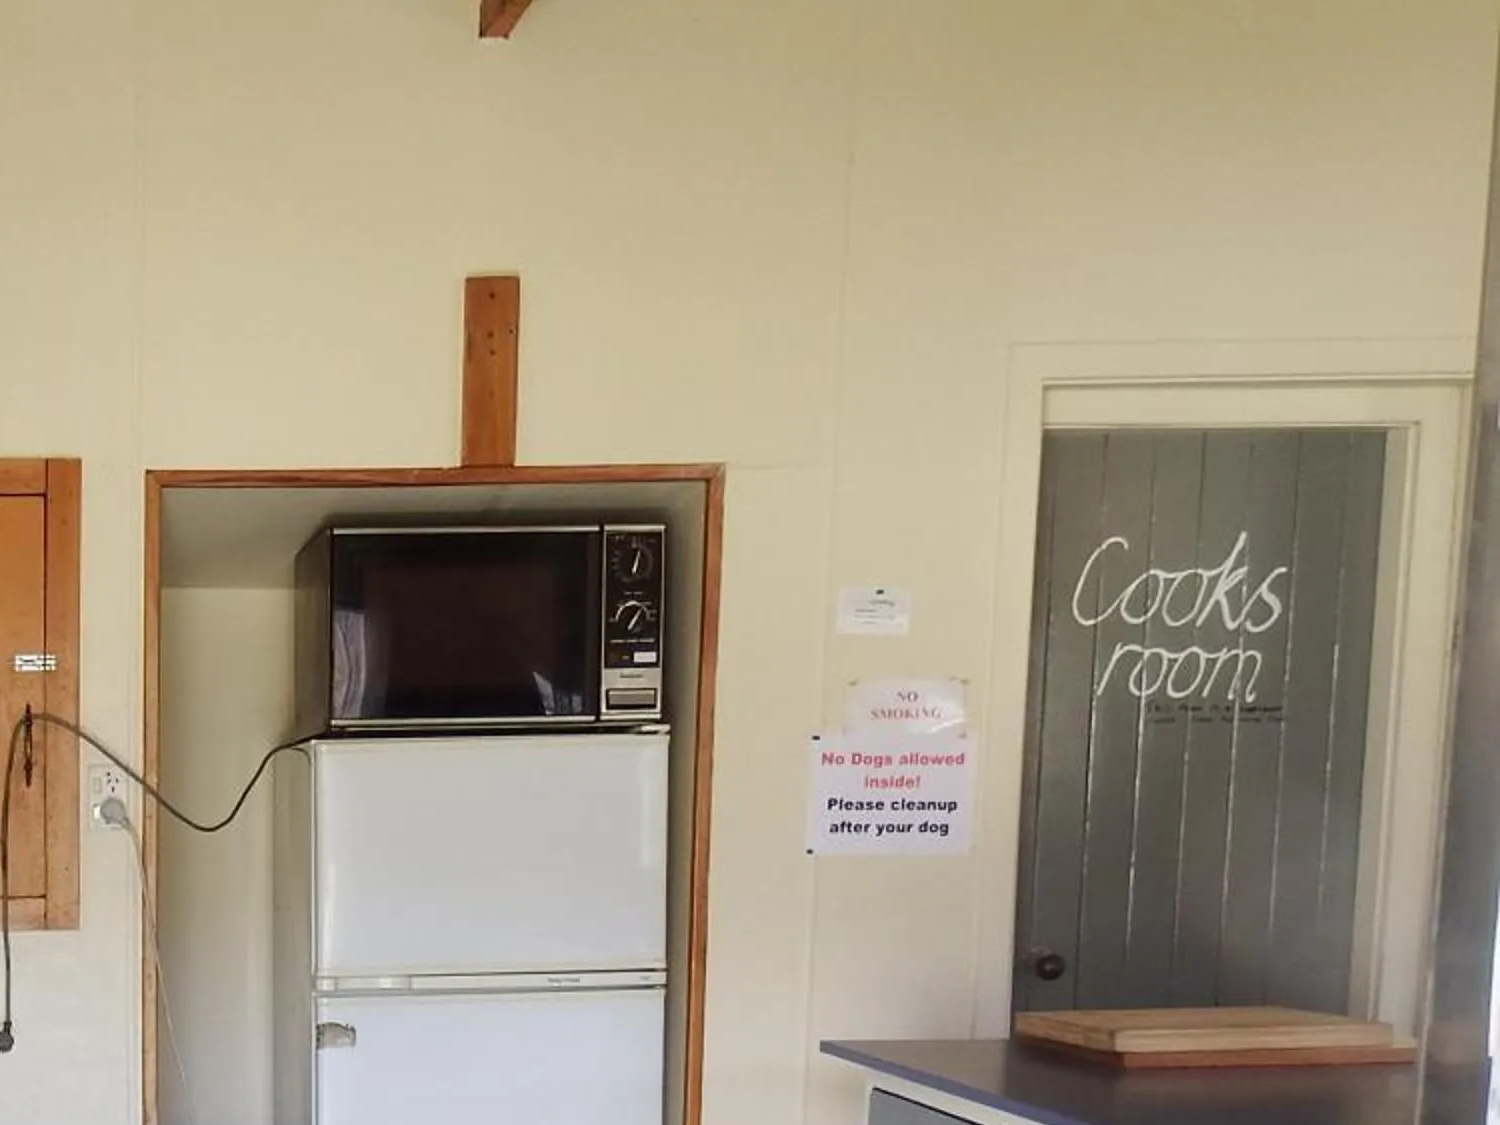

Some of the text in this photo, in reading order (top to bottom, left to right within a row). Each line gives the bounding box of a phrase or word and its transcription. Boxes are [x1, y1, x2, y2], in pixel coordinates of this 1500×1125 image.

[1071, 531, 1288, 633] Cooks
[1096, 642, 1263, 703] room
[896, 690, 919, 703] NO
[869, 706, 942, 720] SMOKING
[820, 752, 965, 768] No Dogs allowed
[864, 774, 922, 789] inside!
[827, 797, 958, 814] Please cleanup
[829, 819, 950, 837] after your dog
